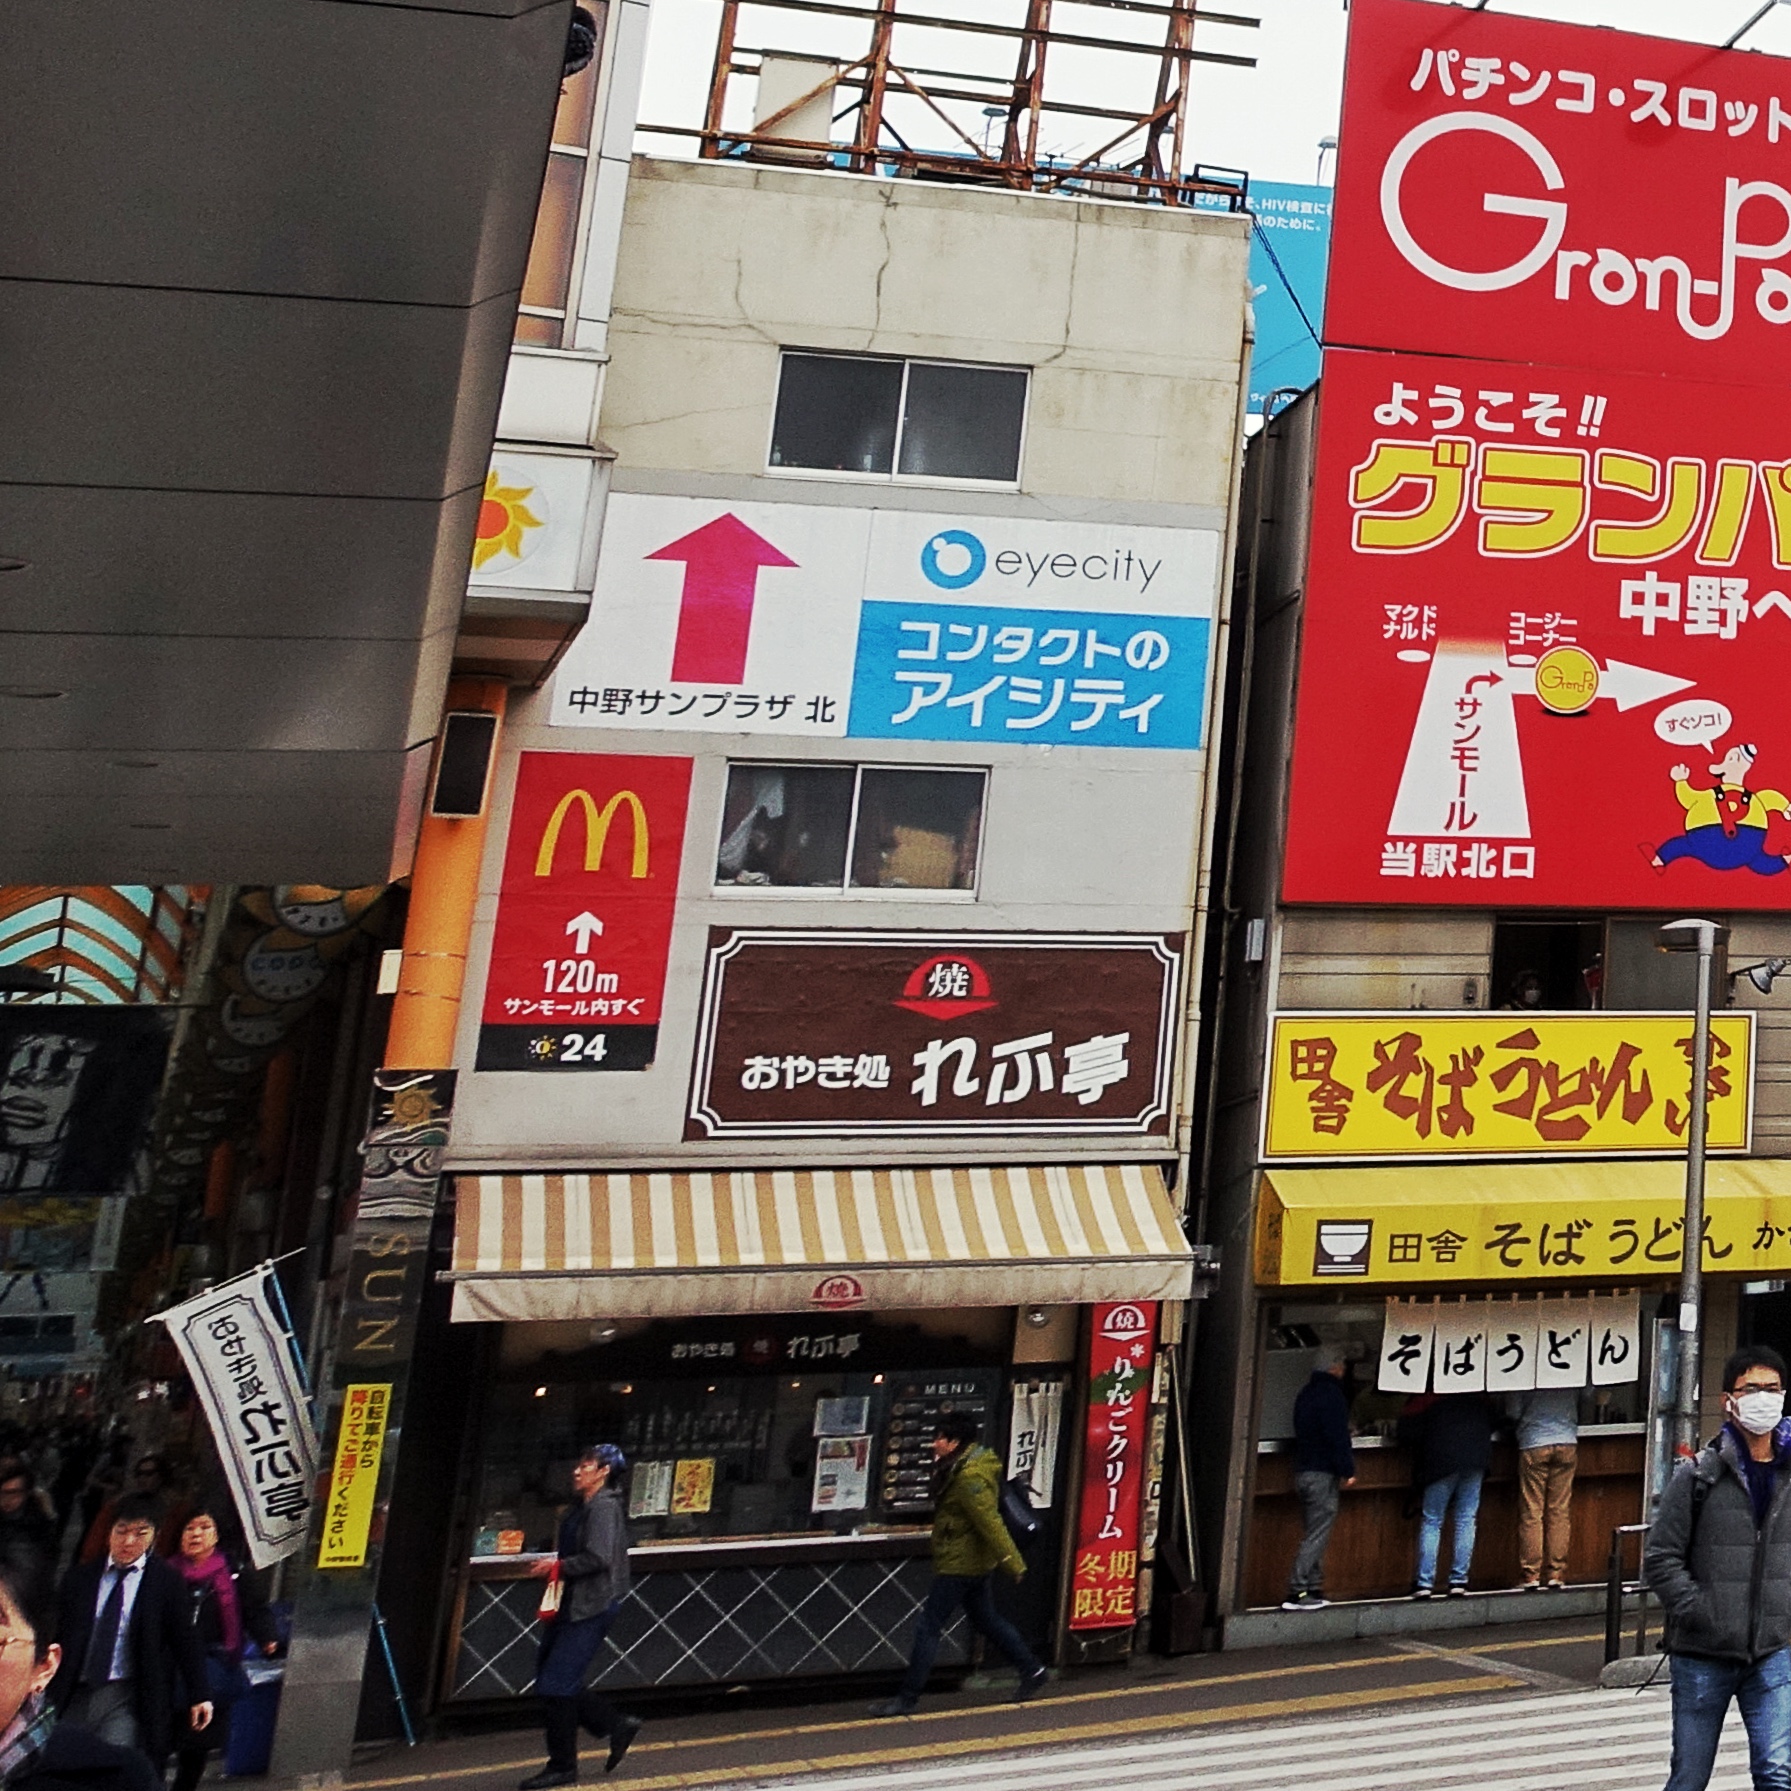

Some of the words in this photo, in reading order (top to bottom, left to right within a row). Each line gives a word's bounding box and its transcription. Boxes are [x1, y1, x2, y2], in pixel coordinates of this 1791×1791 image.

[1373, 382, 1608, 438] ようこそ!!
[995, 548, 1162, 594] eyecity
[1382, 603, 1439, 622] マクド
[1509, 610, 1580, 629] コージー
[897, 621, 1171, 671] コンタクトの
[1382, 621, 1438, 641] ナルド
[1509, 628, 1580, 646] コーナー
[891, 671, 1165, 734] アイシティ
[1665, 710, 1724, 733] すぐソコ!
[1444, 695, 1482, 833] サンモール
[1379, 842, 1536, 881] 当駅北口
[542, 959, 618, 994] 120m
[927, 963, 971, 999] 焼
[504, 998, 645, 1016] サンモール内すぐ
[560, 1033, 608, 1062] 24
[741, 1053, 891, 1091] おやき処
[1289, 1037, 1354, 1137] 田舎
[1365, 1026, 1655, 1143] そばうどん
[1386, 1231, 1469, 1265] 田舎
[353, 1233, 411, 1353] SUN
[1384, 1328, 1631, 1377] そばうどん
[923, 1380, 977, 1396] MENU
[360, 1389, 385, 1469] 自転車から
[1098, 1351, 1150, 1541] りんごクリーム
[1076, 1548, 1138, 1583] 冬期
[1073, 1584, 1137, 1619] 限定
